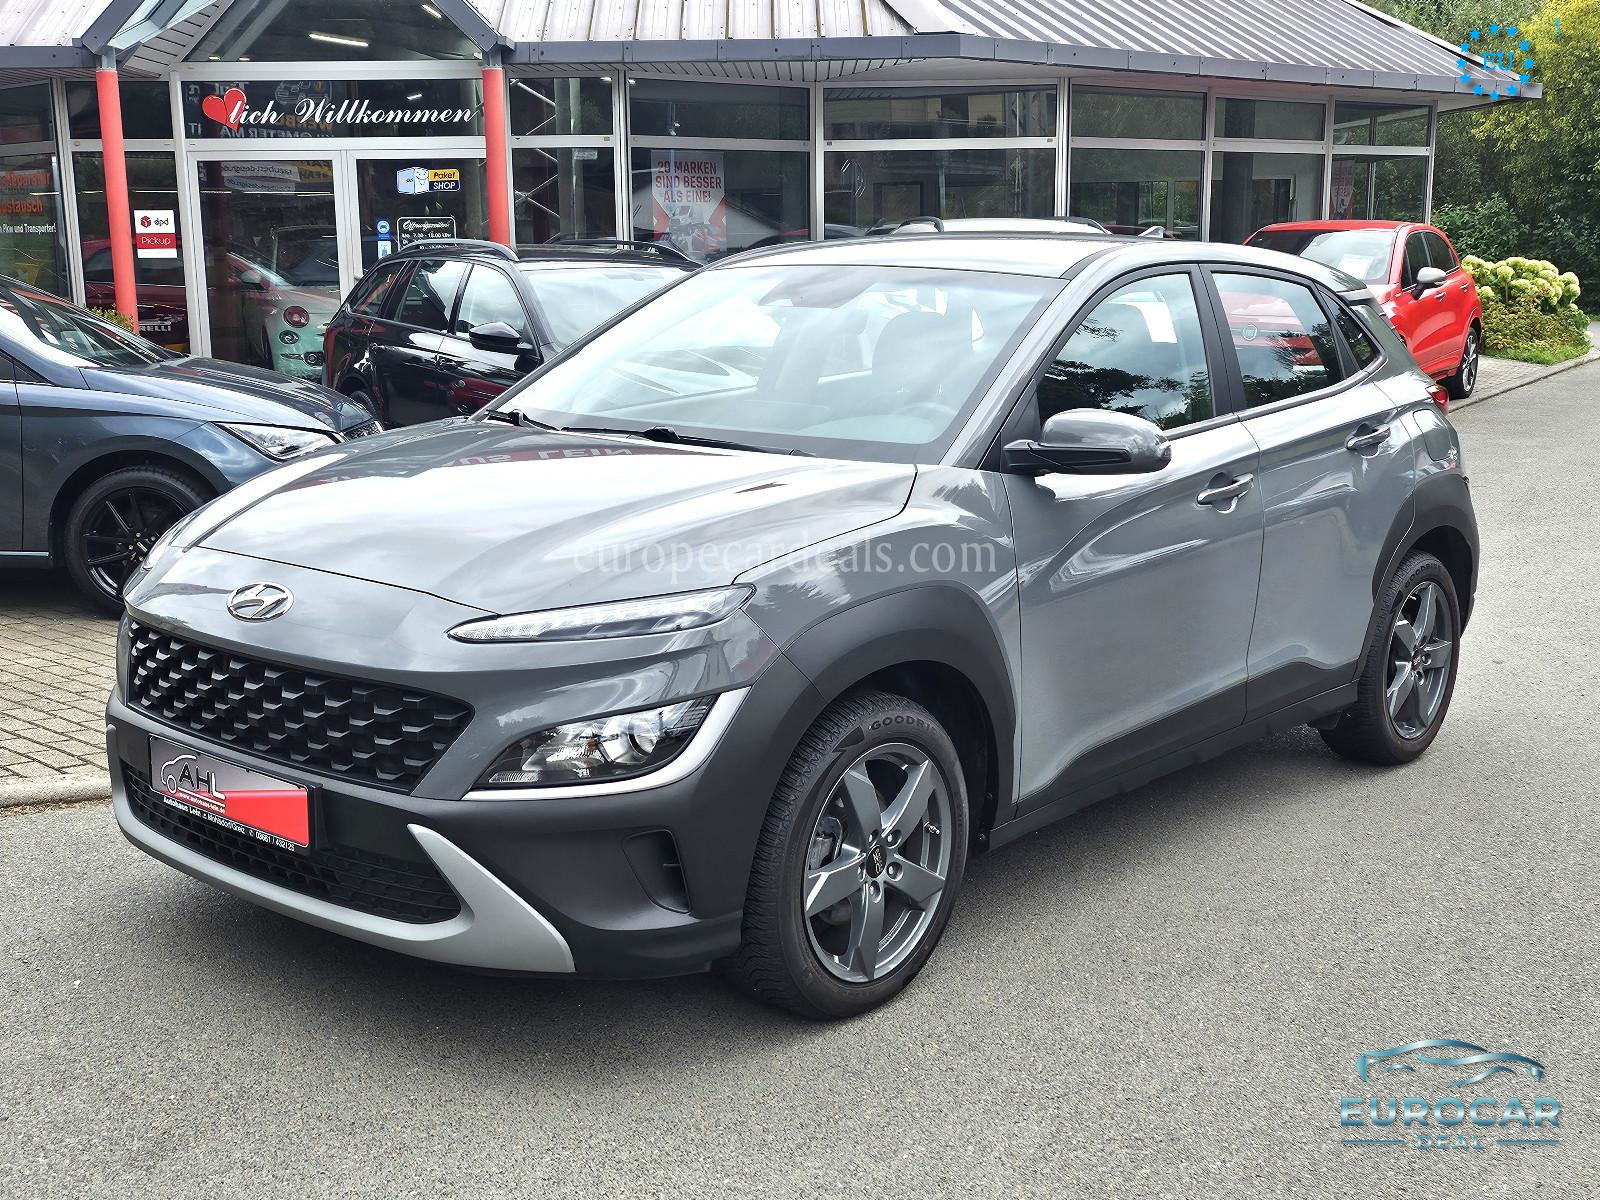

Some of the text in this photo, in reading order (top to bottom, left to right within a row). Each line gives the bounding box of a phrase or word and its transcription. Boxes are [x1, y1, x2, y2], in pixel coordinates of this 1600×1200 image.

[295, 97, 479, 124] Willkommen
[674, 162, 717, 174] MARKEN
[433, 182, 456, 190] SHOP
[656, 176, 721, 189] SIND BESSER
[664, 191, 711, 203] ALS EINE!
[154, 217, 169, 227] dpd
[25, 222, 57, 236] Transporter!
[141, 236, 171, 246] Pickup
[179, 761, 226, 800] AHL
[163, 796, 190, 812] Autohaus
[189, 805, 202, 818] Lein
